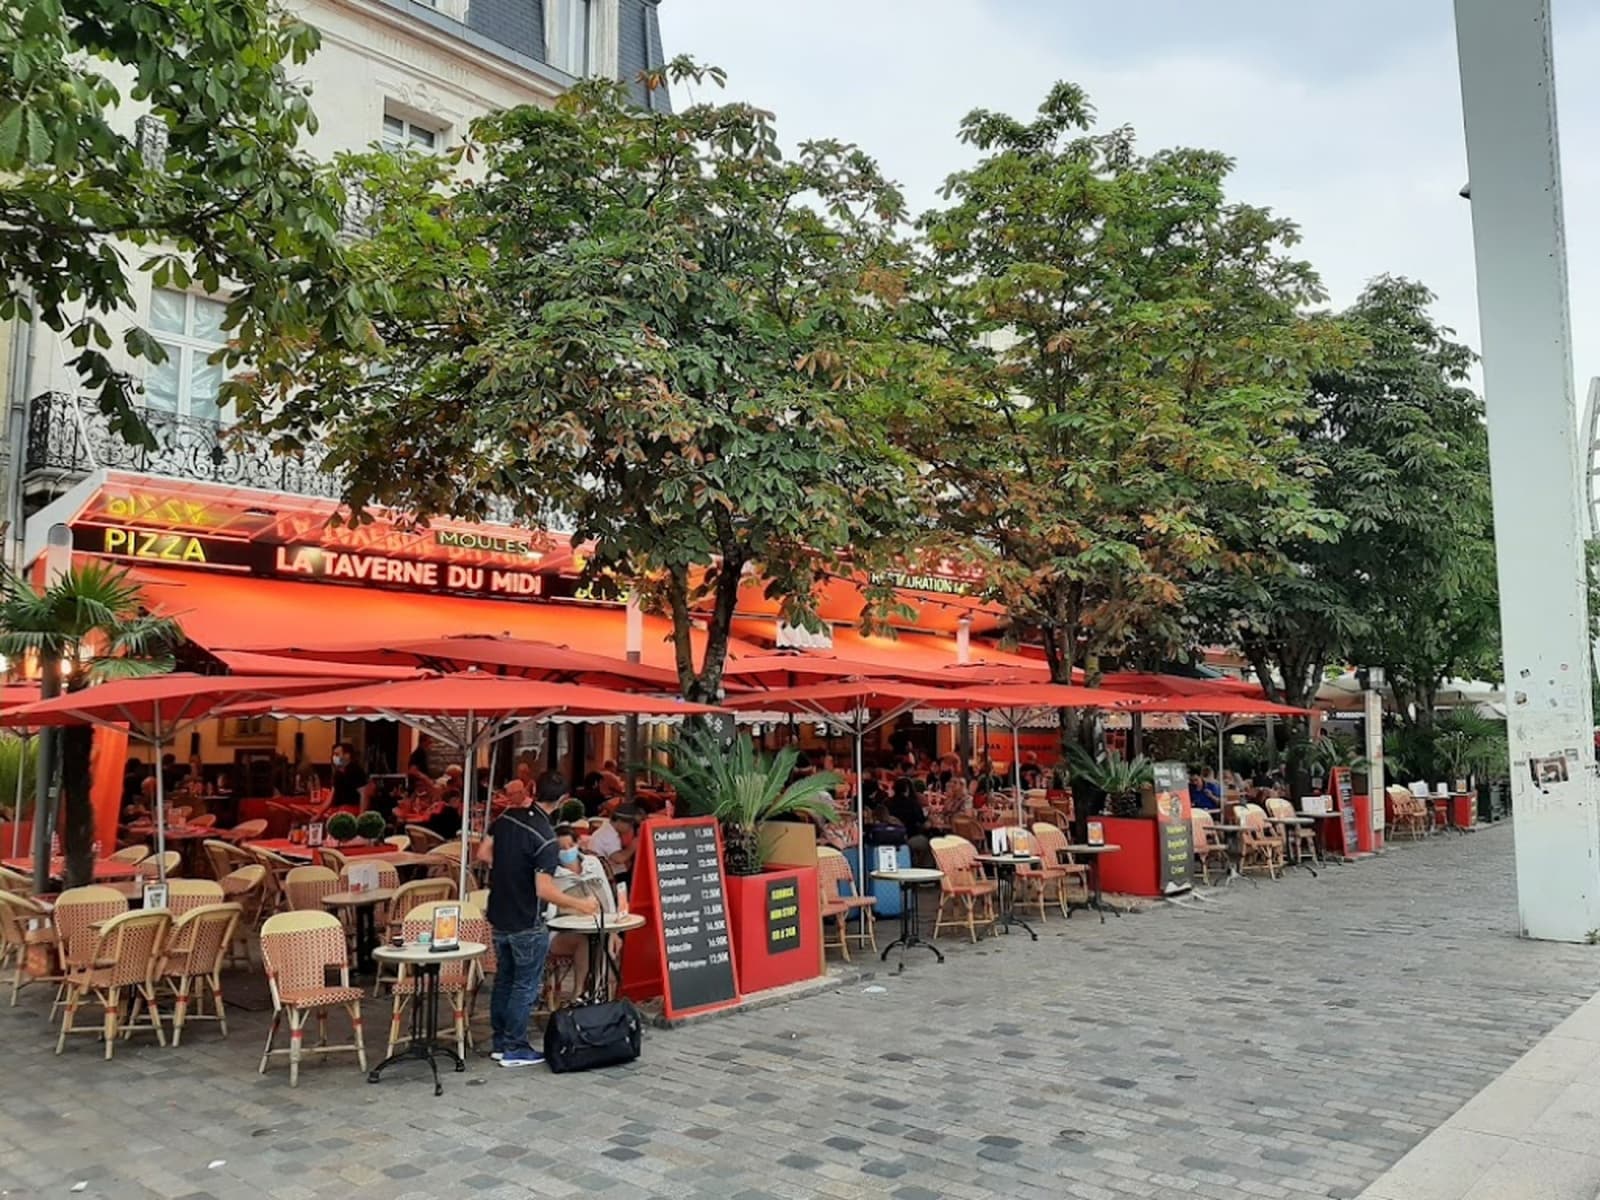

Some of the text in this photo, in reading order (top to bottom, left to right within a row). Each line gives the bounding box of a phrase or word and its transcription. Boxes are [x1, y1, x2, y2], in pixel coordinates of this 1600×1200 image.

[104, 527, 206, 563] PIZZA
[438, 531, 529, 554] MOULES
[275, 546, 313, 574] LA
[321, 551, 438, 586] TAVERNE
[447, 565, 483, 591] DU
[491, 571, 542, 595] MIDI
